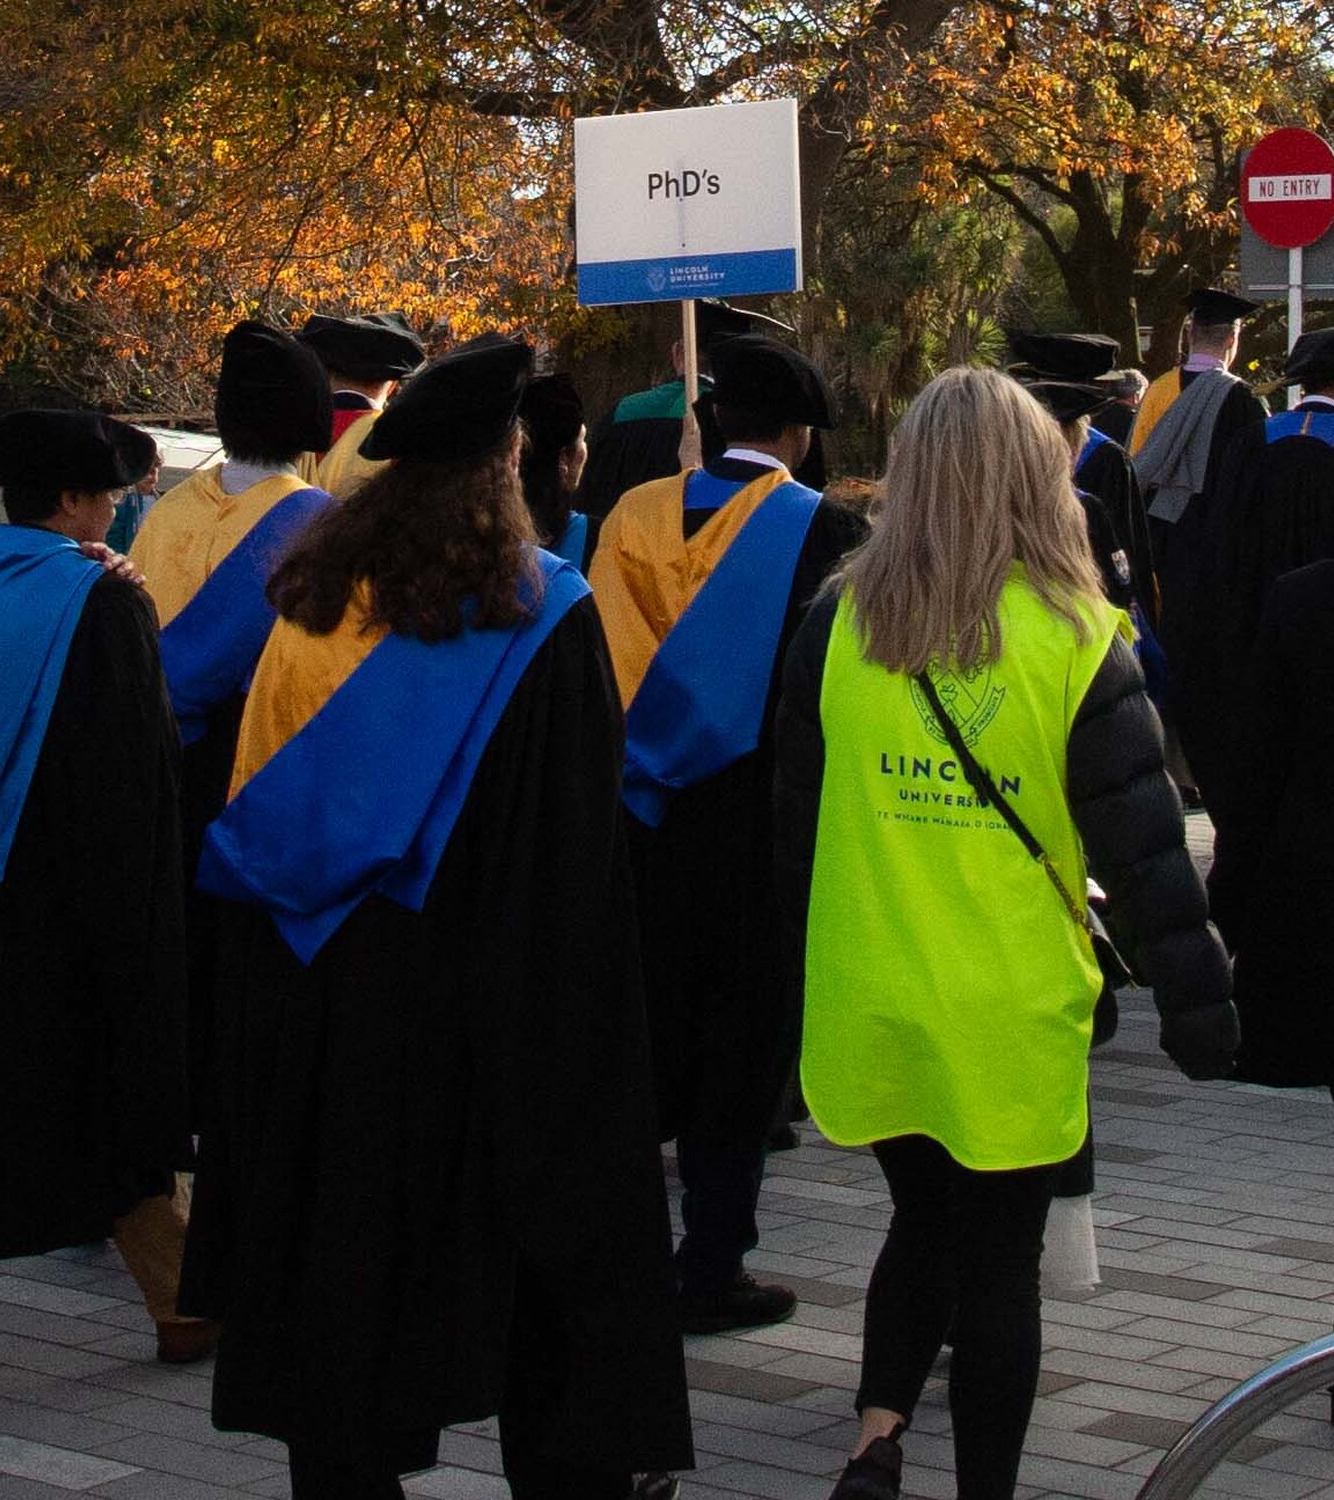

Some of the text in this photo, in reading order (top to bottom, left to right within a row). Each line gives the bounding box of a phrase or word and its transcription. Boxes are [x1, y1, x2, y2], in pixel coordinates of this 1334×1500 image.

[648, 169, 720, 200] PhD's
[1259, 179, 1321, 197] NO ENTRY
[669, 265, 708, 275] LINCOLN
[669, 272, 725, 283] UNIVERSITY
[881, 753, 1021, 797] LINCN
